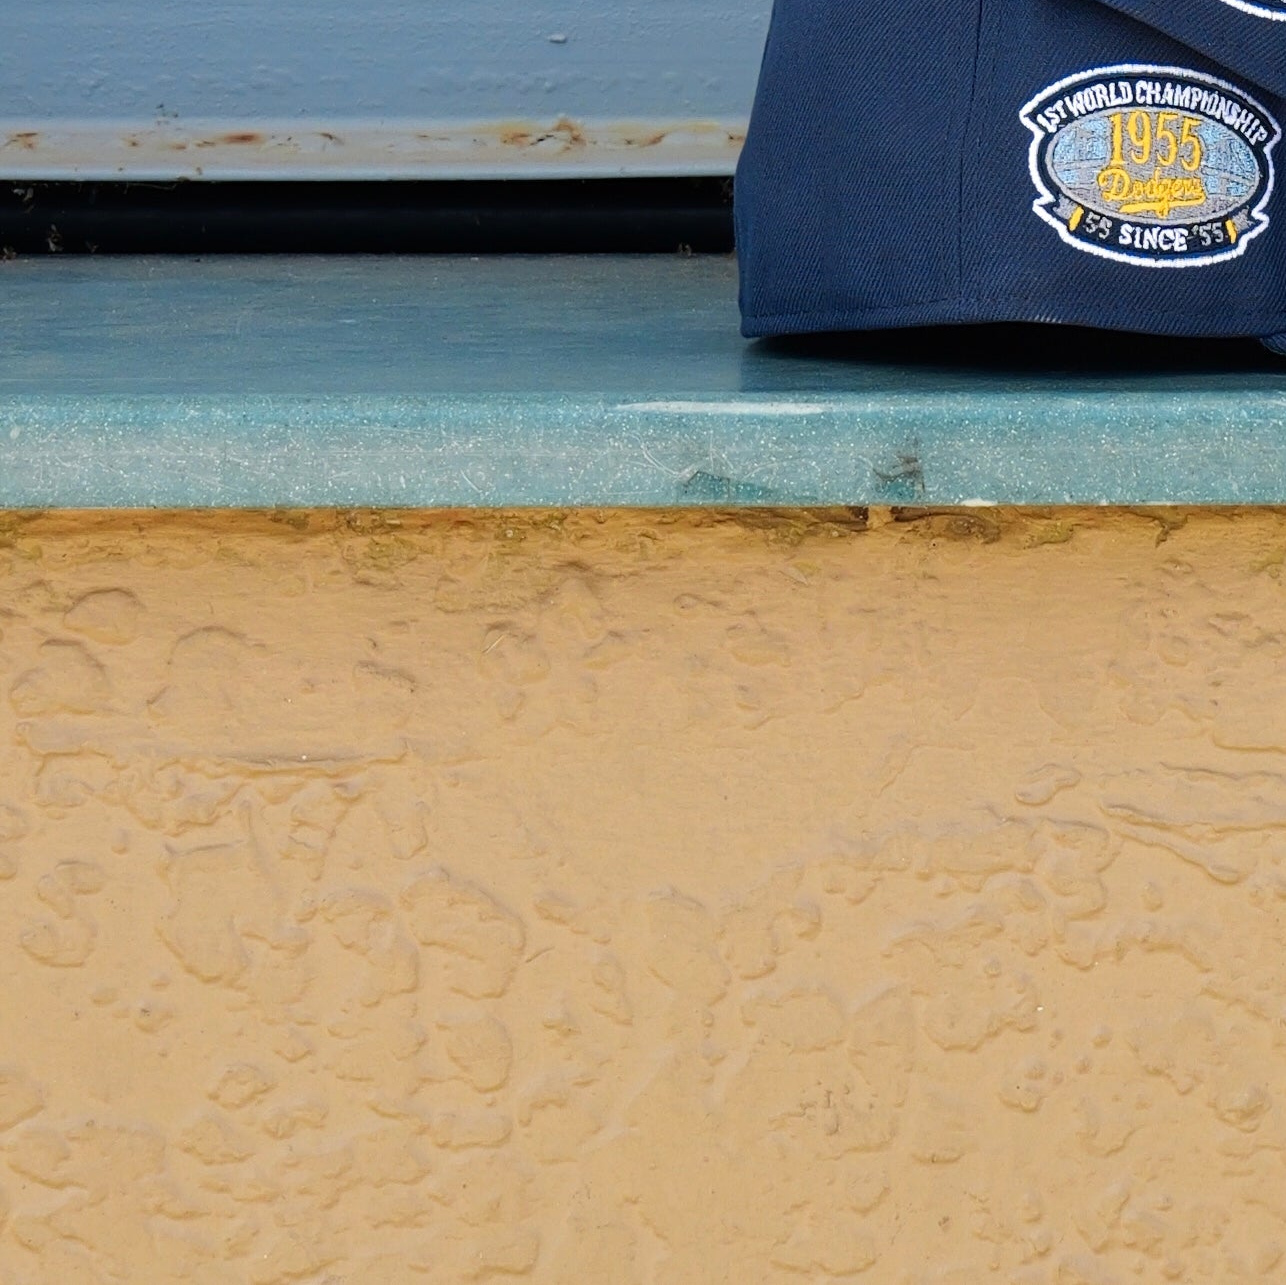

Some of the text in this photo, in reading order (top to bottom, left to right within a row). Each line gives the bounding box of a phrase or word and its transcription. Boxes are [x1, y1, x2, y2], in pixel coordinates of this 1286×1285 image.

[1036, 80, 1268, 145] 1ST WORLD CHAMPIONSHIP
[1108, 110, 1202, 171] 1955
[1097, 166, 1206, 219] Dodgers
[1119, 224, 1189, 252] SINCE
